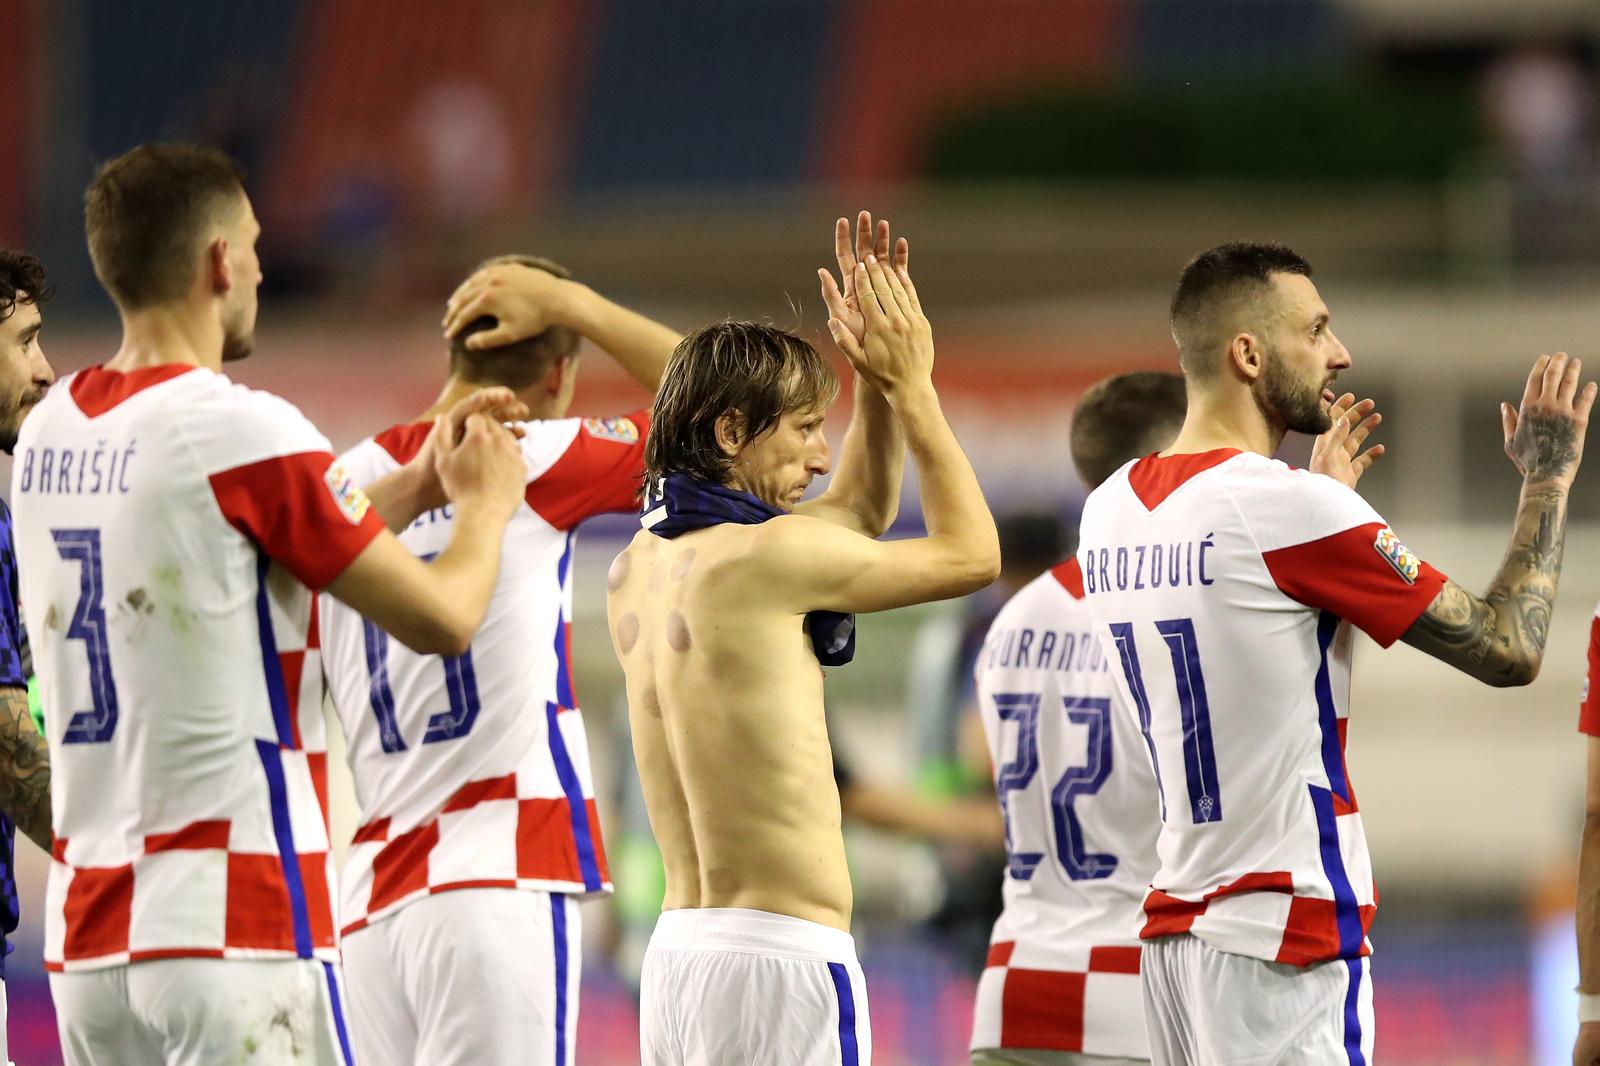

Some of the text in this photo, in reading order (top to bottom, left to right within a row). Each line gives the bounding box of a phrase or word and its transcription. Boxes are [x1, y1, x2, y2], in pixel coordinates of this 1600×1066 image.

[21, 438, 136, 493] BARIŠIĆ
[51, 529, 119, 744] 3
[1087, 532, 1215, 593] BROZOVIĆ
[992, 693, 1119, 880] 22
[1109, 618, 1223, 824] 11
